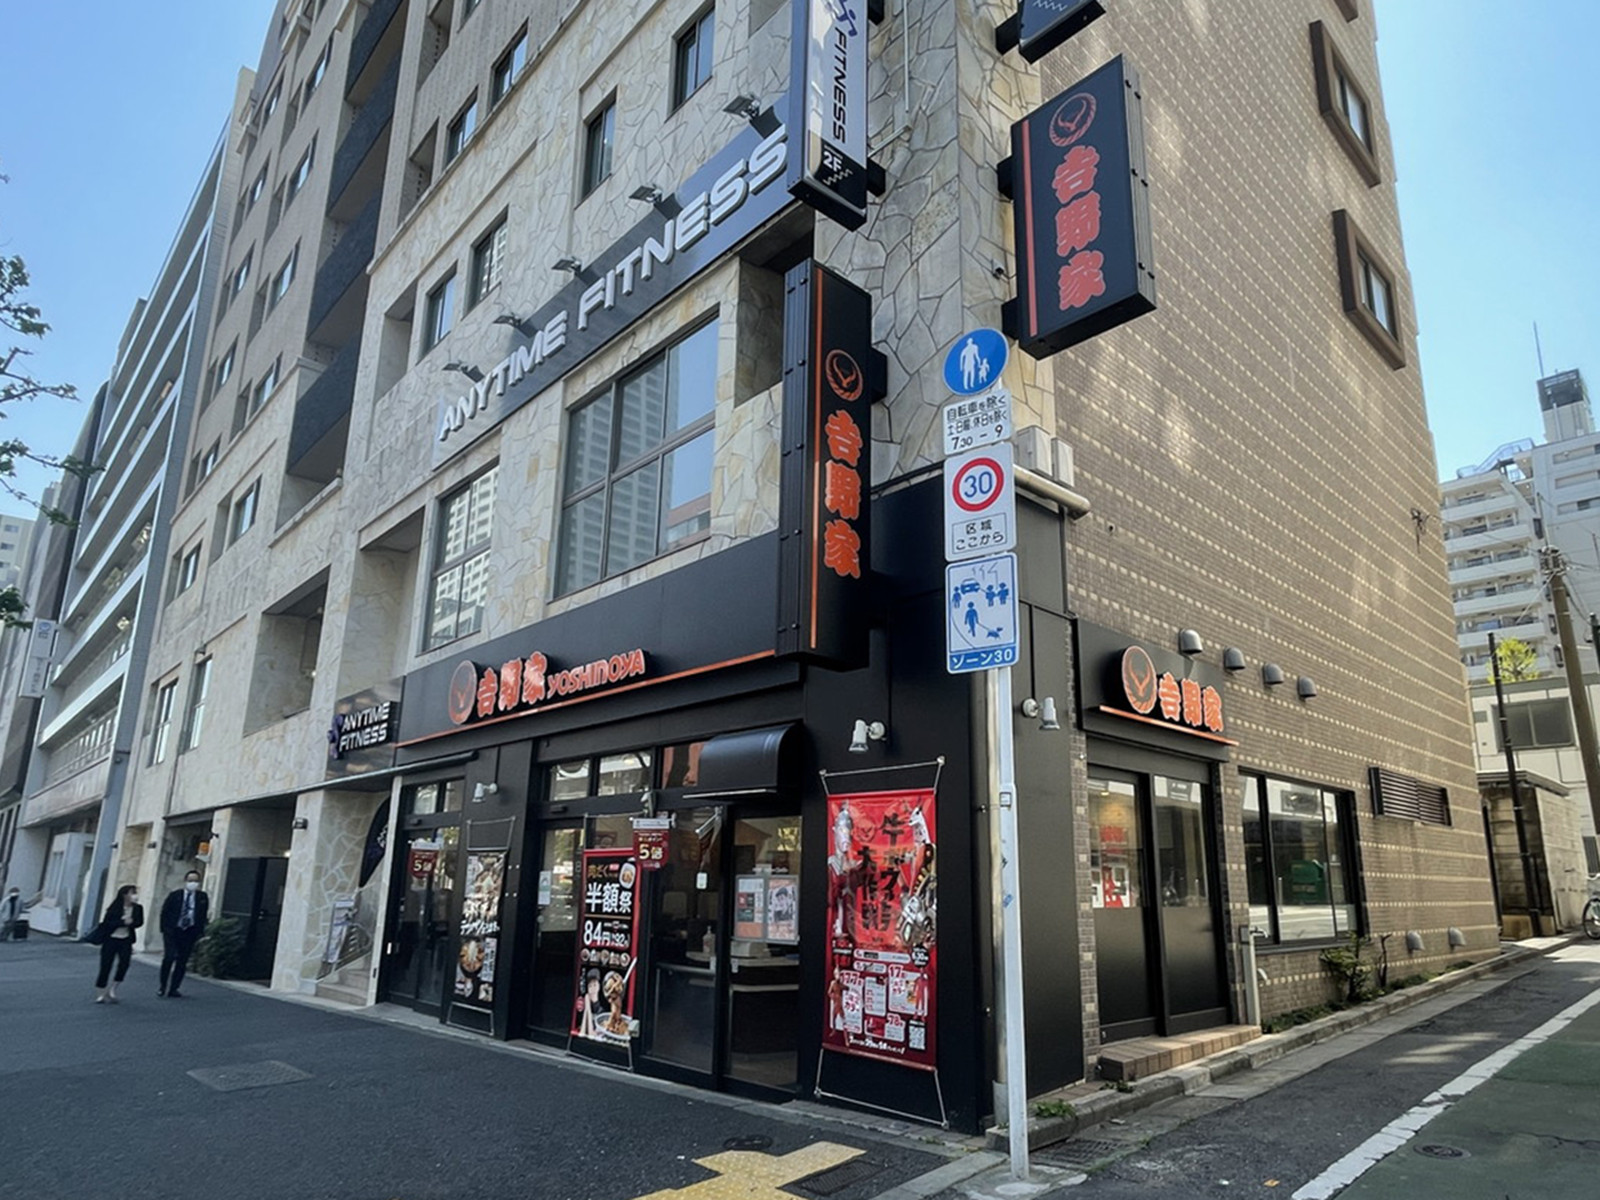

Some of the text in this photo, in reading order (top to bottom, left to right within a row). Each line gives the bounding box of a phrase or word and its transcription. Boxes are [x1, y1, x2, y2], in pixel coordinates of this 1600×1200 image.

[833, 27, 847, 144] FITNESS
[823, 151, 842, 172] 2F
[438, 123, 788, 441] ANYTIME FITNESS
[994, 424, 1003, 437] 9
[964, 471, 993, 498] 30
[955, 531, 1004, 550] ここから
[477, 648, 645, 718] 吉野家 YOSHINOYA
[341, 701, 391, 733] ANYTIME
[1158, 671, 1224, 732] 吉野家
[339, 722, 388, 752] FITNESS
[585, 881, 633, 913] 半額祭
